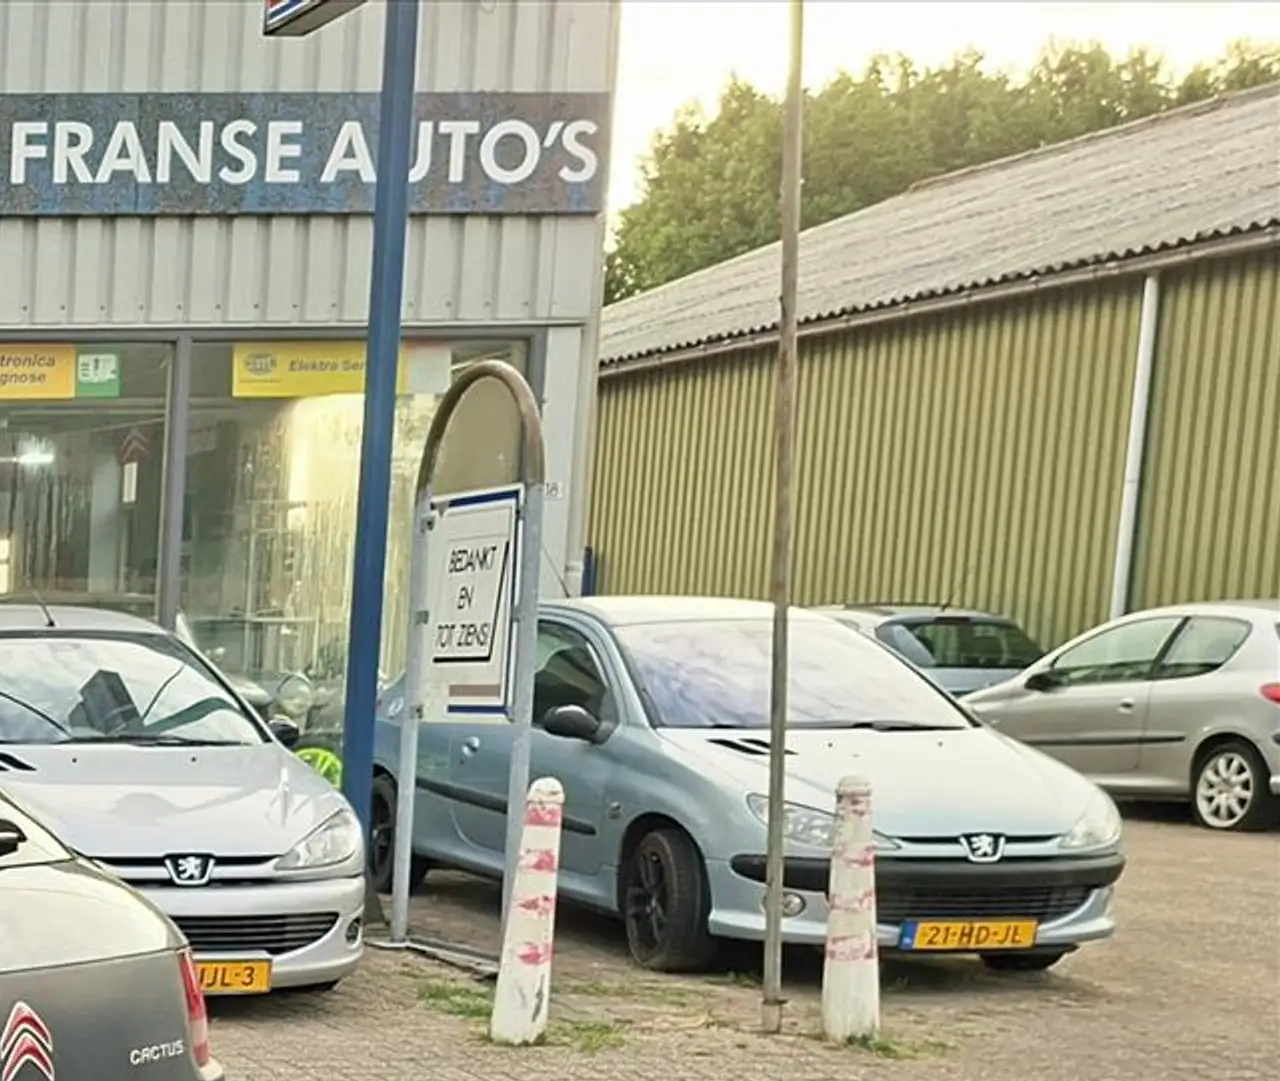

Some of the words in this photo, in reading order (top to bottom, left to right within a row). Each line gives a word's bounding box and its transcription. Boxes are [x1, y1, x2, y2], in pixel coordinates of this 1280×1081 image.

[10, 120, 303, 185] FRANSE
[448, 546, 497, 574] BEDANKT
[456, 585, 476, 611] EN
[435, 624, 456, 649] TOT
[925, 925, 1023, 946] 21-HD-JL
[130, 1039, 184, 1066] CACTUS
